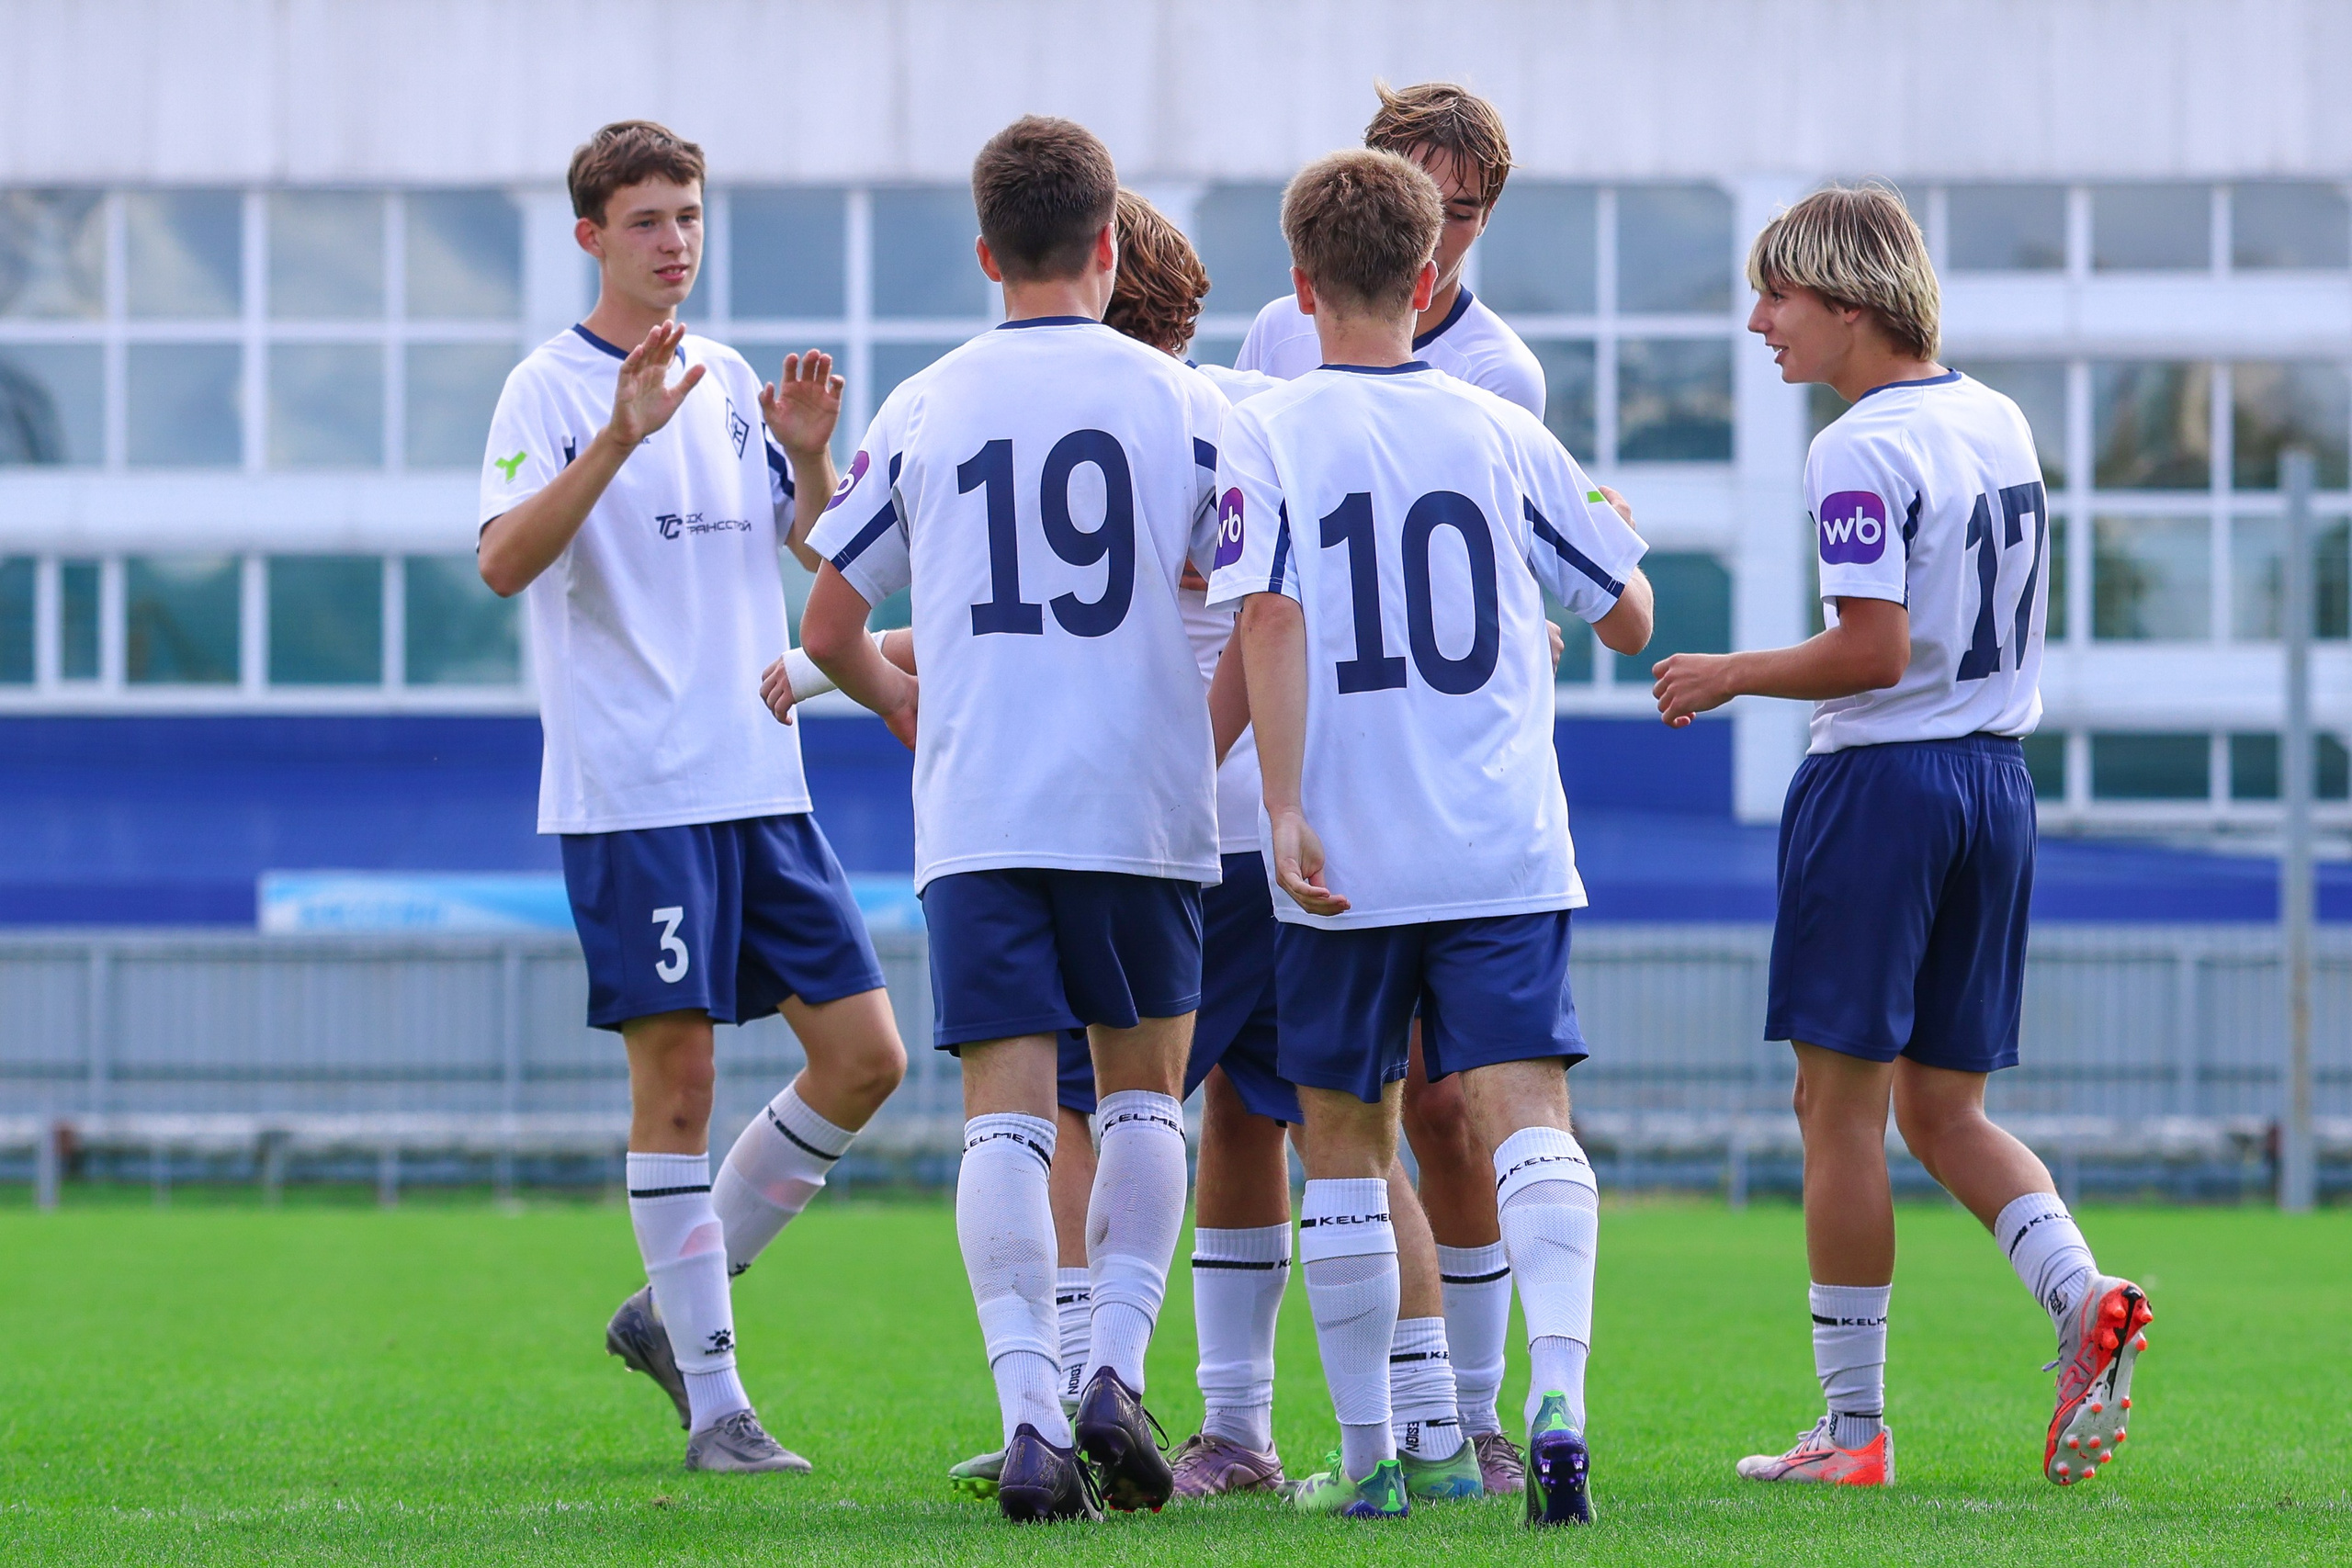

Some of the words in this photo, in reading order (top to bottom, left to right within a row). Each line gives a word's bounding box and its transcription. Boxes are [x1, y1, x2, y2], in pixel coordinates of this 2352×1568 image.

[686, 520, 752, 536] ТРАНССОЙ
[956, 429, 1136, 637] 19
[1823, 506, 1882, 546] wb
[1320, 491, 1501, 695] 10
[1956, 481, 2046, 682] 17
[651, 906, 690, 984] 3
[1104, 1113, 1179, 1132] KELME
[1510, 1156, 1586, 1175] KELME
[1319, 1213, 1388, 1226] KELME
[1841, 1316, 1887, 1326] KELM
[1405, 1421, 1419, 1453] ESIGN
